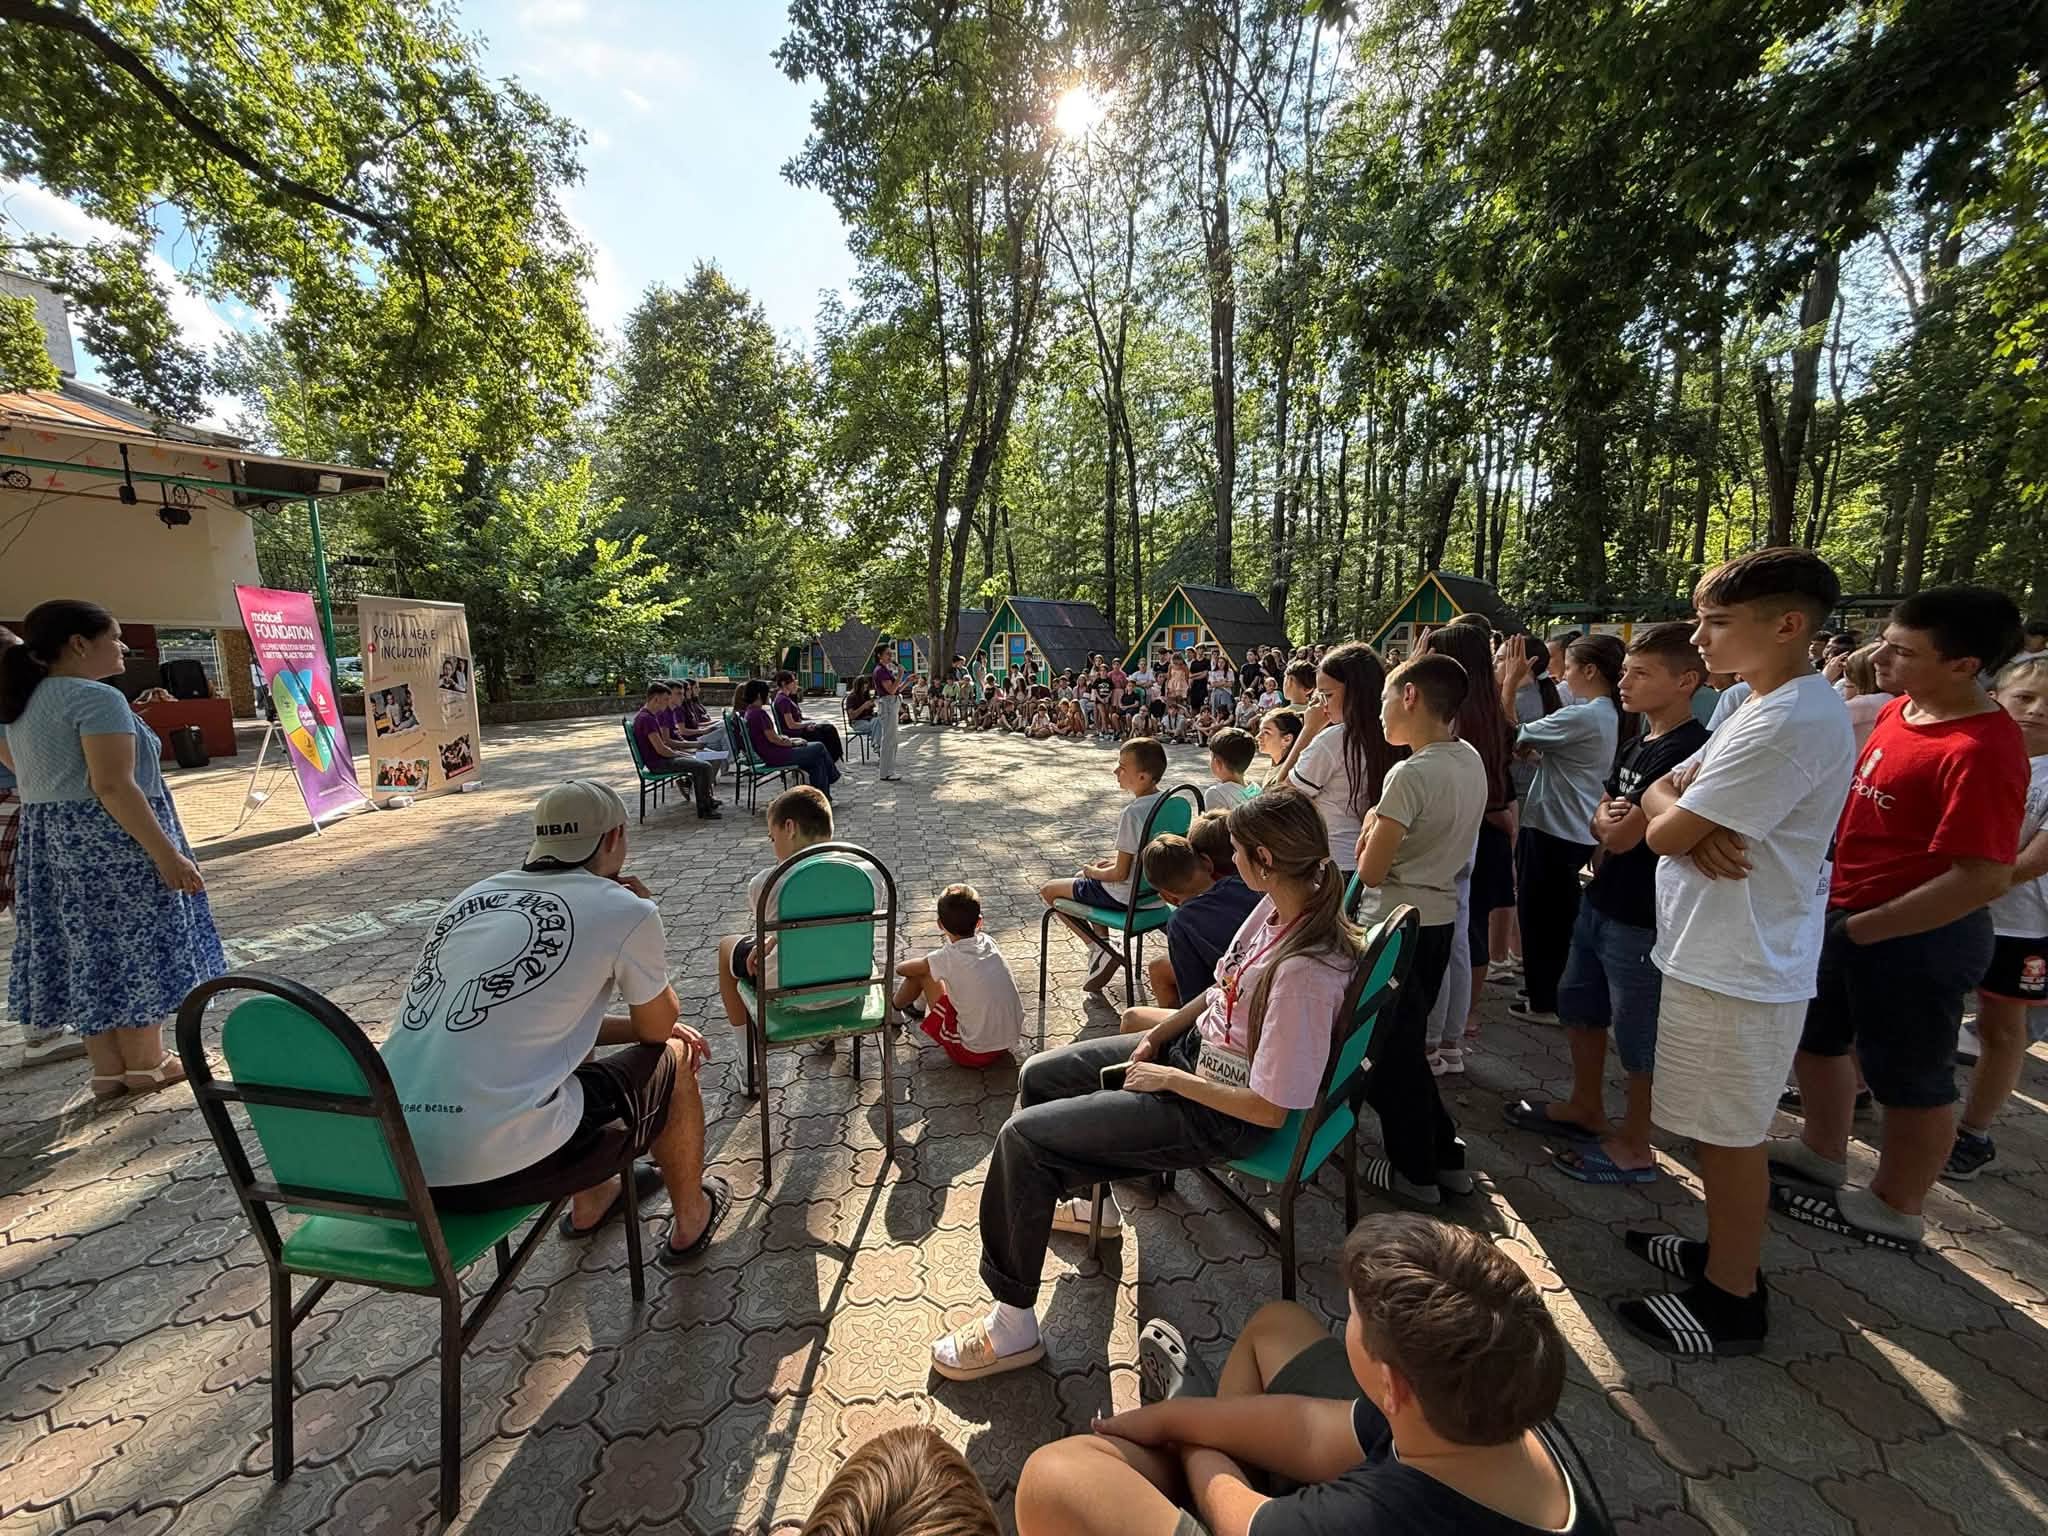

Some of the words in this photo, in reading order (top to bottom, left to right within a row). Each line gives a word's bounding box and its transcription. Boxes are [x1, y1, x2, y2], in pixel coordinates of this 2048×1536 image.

[254, 623, 314, 640] FOUNDATION
[410, 628, 428, 640] MEA
[431, 629, 438, 640] E
[1199, 1055, 1246, 1084] ARIADNA
[1789, 1207, 1851, 1234] SPORT
